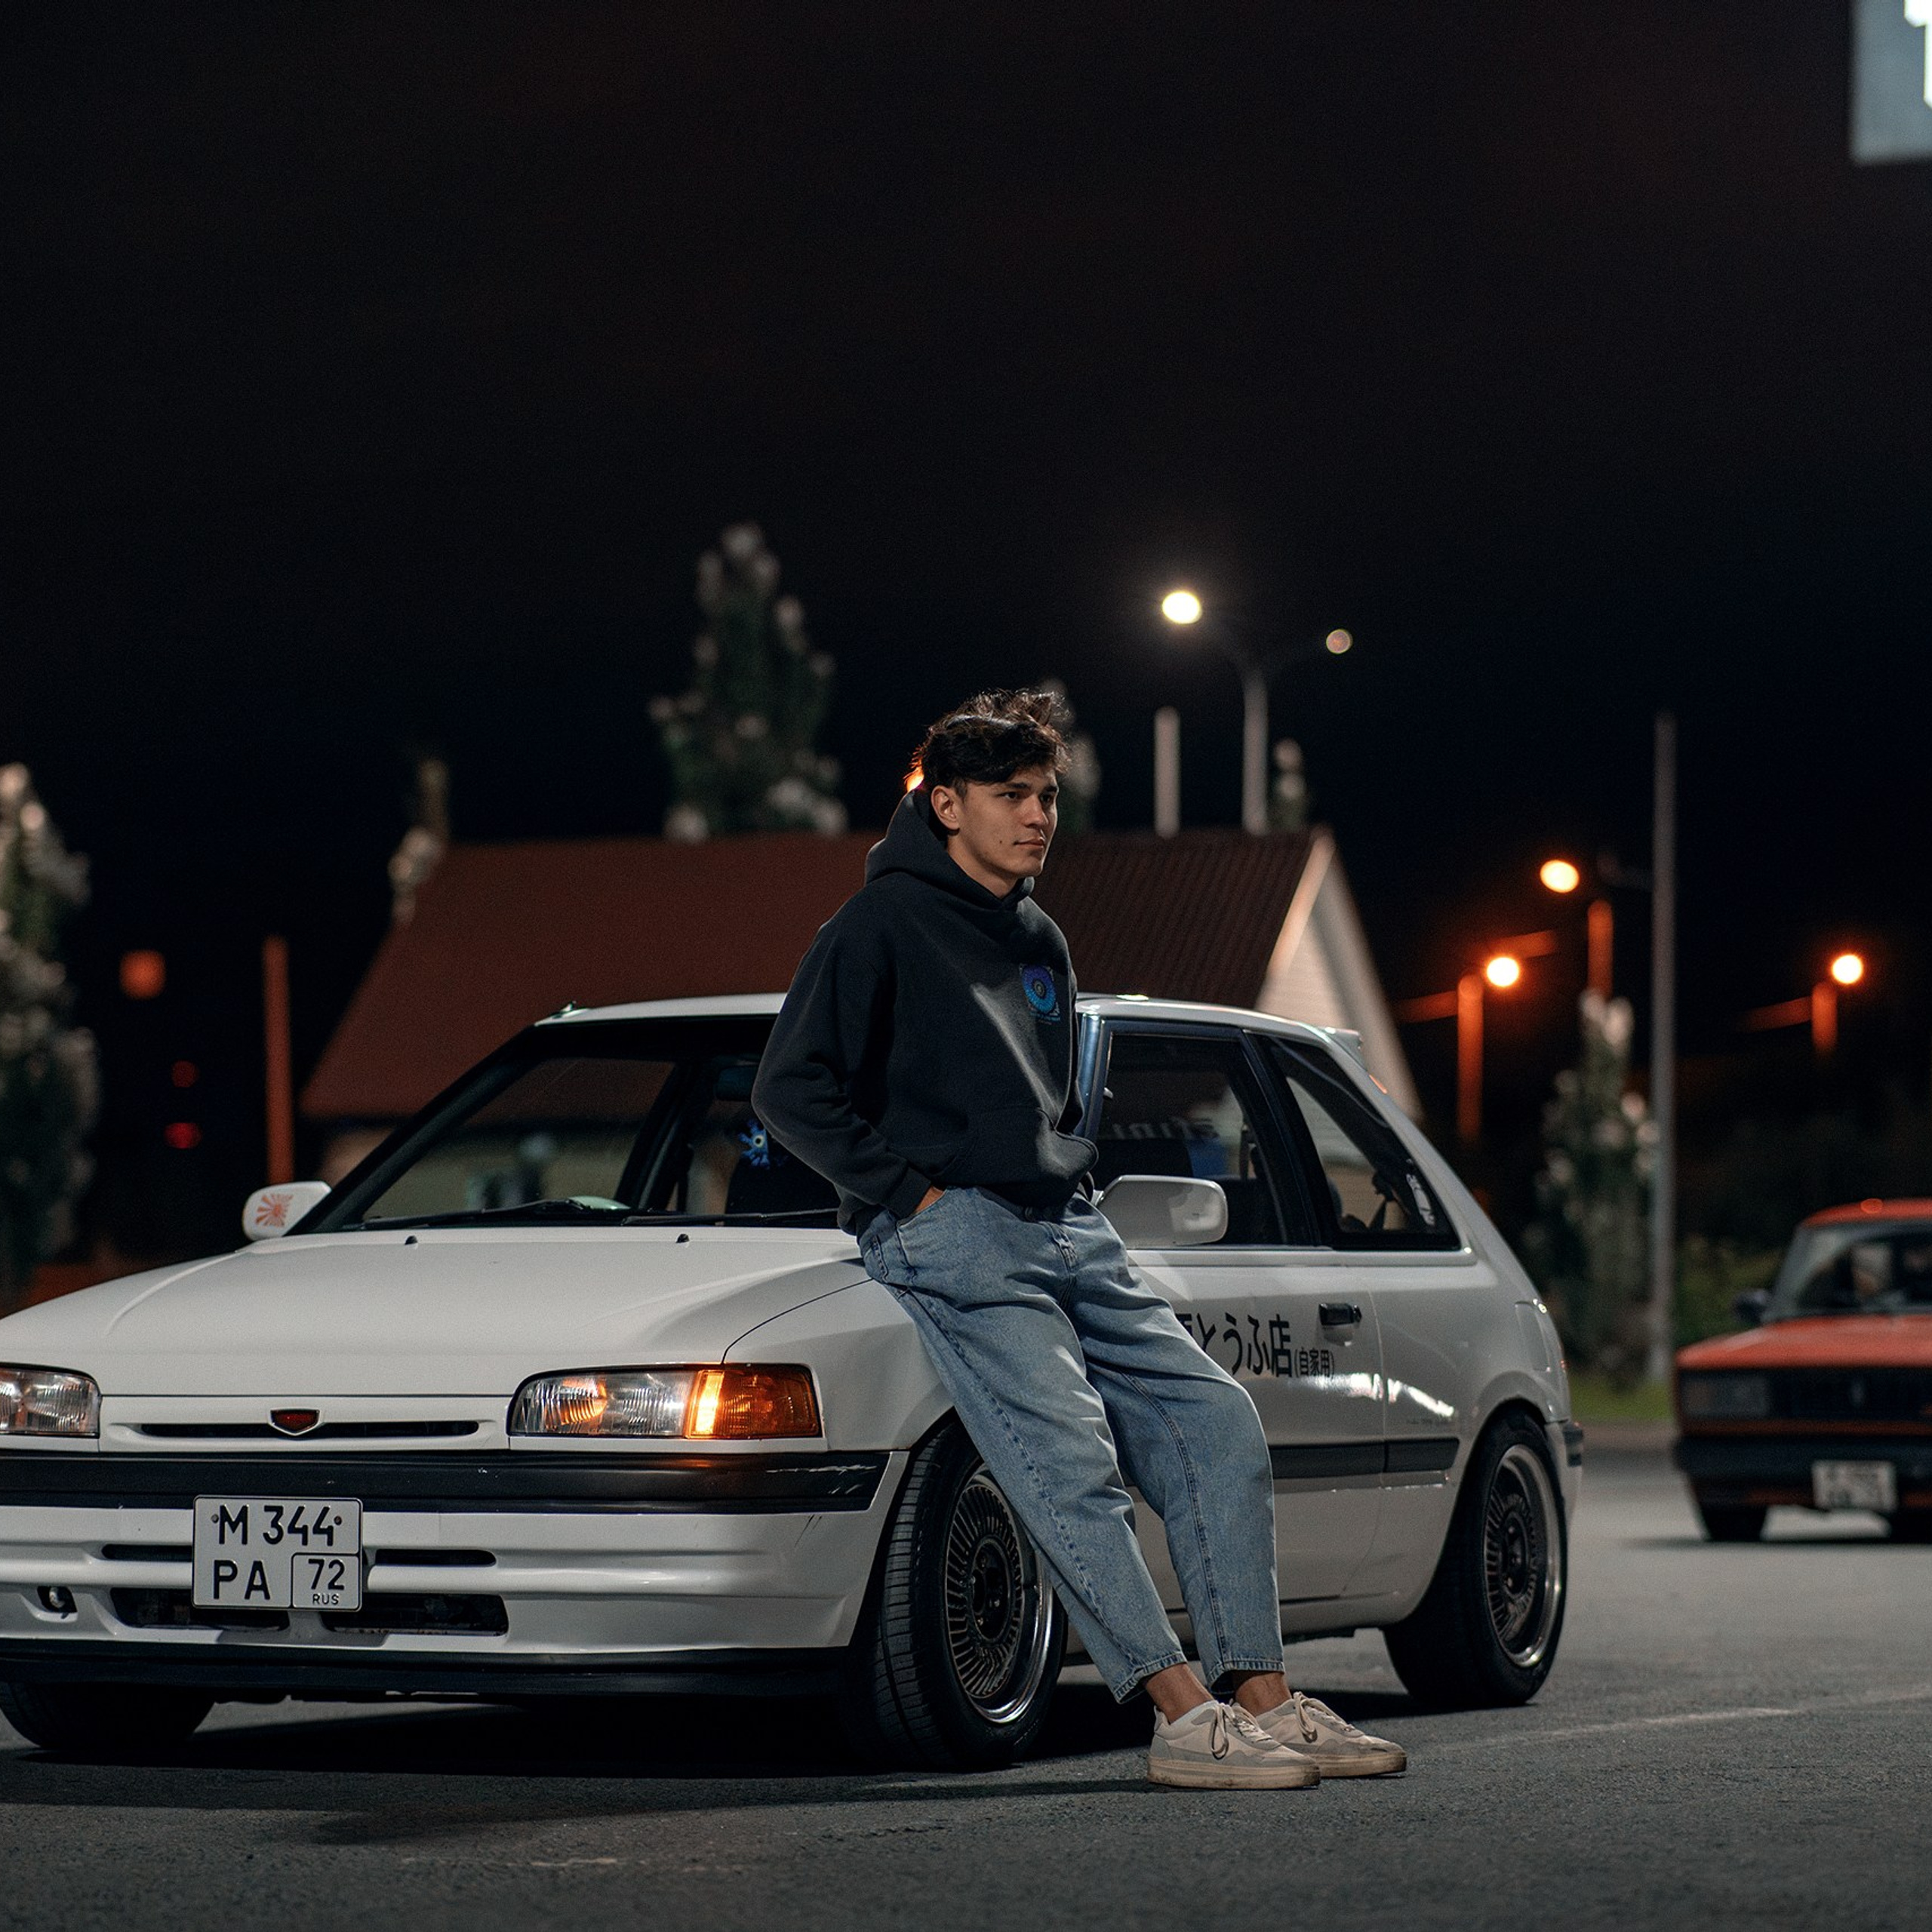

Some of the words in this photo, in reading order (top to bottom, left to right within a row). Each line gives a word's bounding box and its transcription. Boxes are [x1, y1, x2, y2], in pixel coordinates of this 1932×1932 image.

[263, 1505, 334, 1546] 344
[308, 1558, 346, 1591] 72
[312, 1593, 340, 1606] RUS
